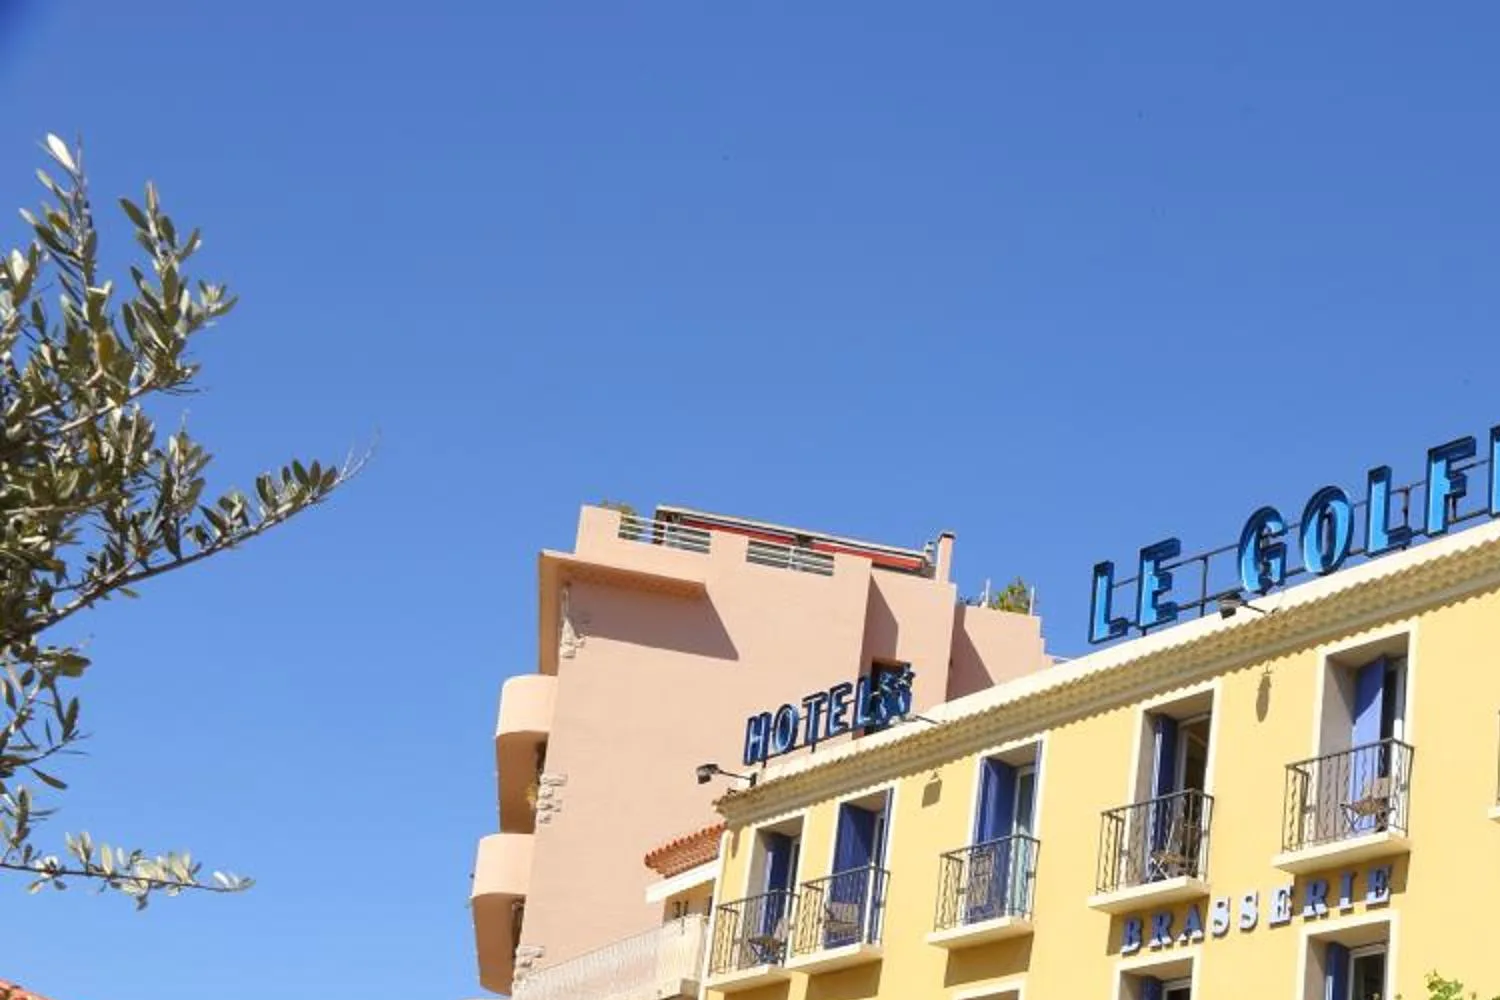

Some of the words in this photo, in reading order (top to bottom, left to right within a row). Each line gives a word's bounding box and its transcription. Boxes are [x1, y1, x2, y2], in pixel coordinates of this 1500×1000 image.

[1088, 537, 1180, 643] LE
[743, 675, 873, 766] HOTEL
[1120, 864, 1392, 955] BRASSERIE
